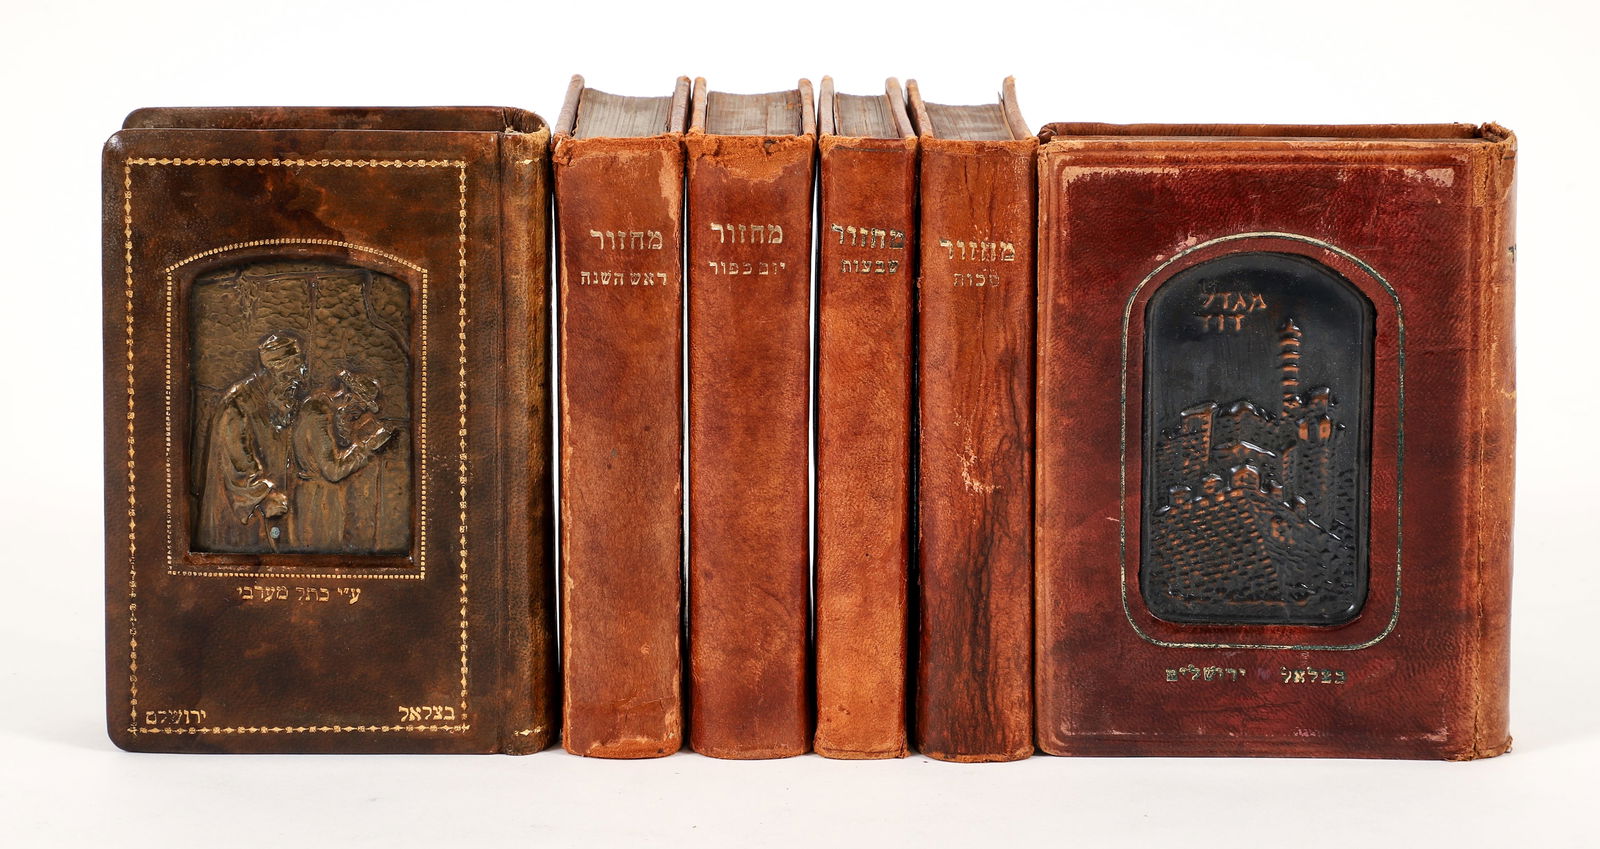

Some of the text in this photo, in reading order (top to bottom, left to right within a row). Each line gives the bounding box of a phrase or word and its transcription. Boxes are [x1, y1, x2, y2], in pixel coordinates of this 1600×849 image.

[590, 229, 664, 250] מחזור
[710, 222, 784, 244] מחזור
[831, 223, 905, 249] מחזור
[939, 237, 1016, 262] מחזור
[709, 261, 786, 275] יום כפור
[841, 259, 900, 274] שבעות
[580, 270, 668, 286] ראש השנה
[953, 272, 1001, 287] סכות
[1200, 281, 1268, 312] מגדל
[236, 585, 289, 602] מערבי
[295, 586, 330, 602] כתל
[1165, 664, 1346, 684] בצלאל ירושלים
[145, 709, 207, 725] ירושלם
[398, 705, 456, 722] בצלאל
